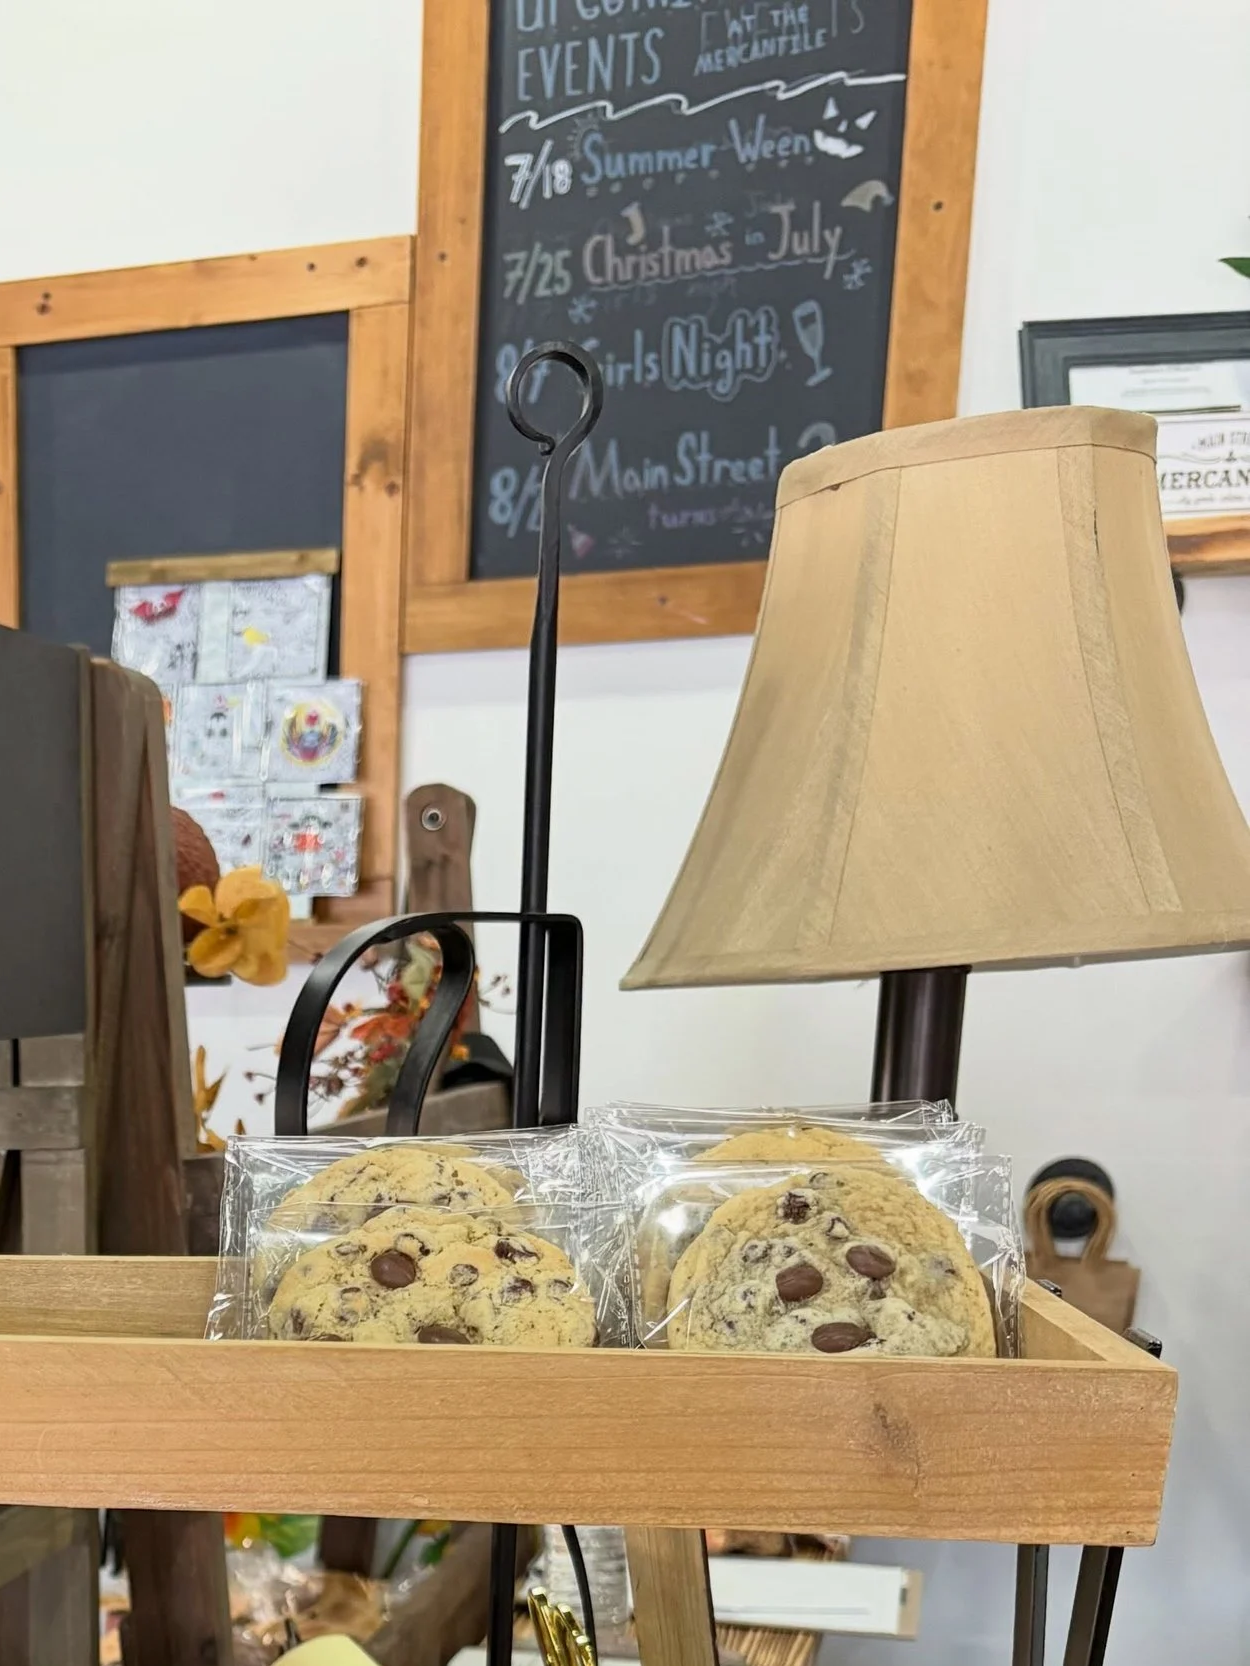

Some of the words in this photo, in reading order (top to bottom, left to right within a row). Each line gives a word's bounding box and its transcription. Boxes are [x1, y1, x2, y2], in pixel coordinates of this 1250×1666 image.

[693, 28, 828, 77] MERCANTILE
[769, 7, 810, 30] THE
[516, 27, 665, 101] EVENTS
[504, 140, 573, 209] 7/18
[580, 132, 718, 185] Summer
[729, 114, 811, 164] Ween
[503, 242, 573, 305] 7/25
[582, 225, 732, 285] Christmas
[768, 201, 842, 281] July
[671, 313, 772, 393] Night
[569, 438, 667, 500] Main
[674, 425, 781, 487] Street
